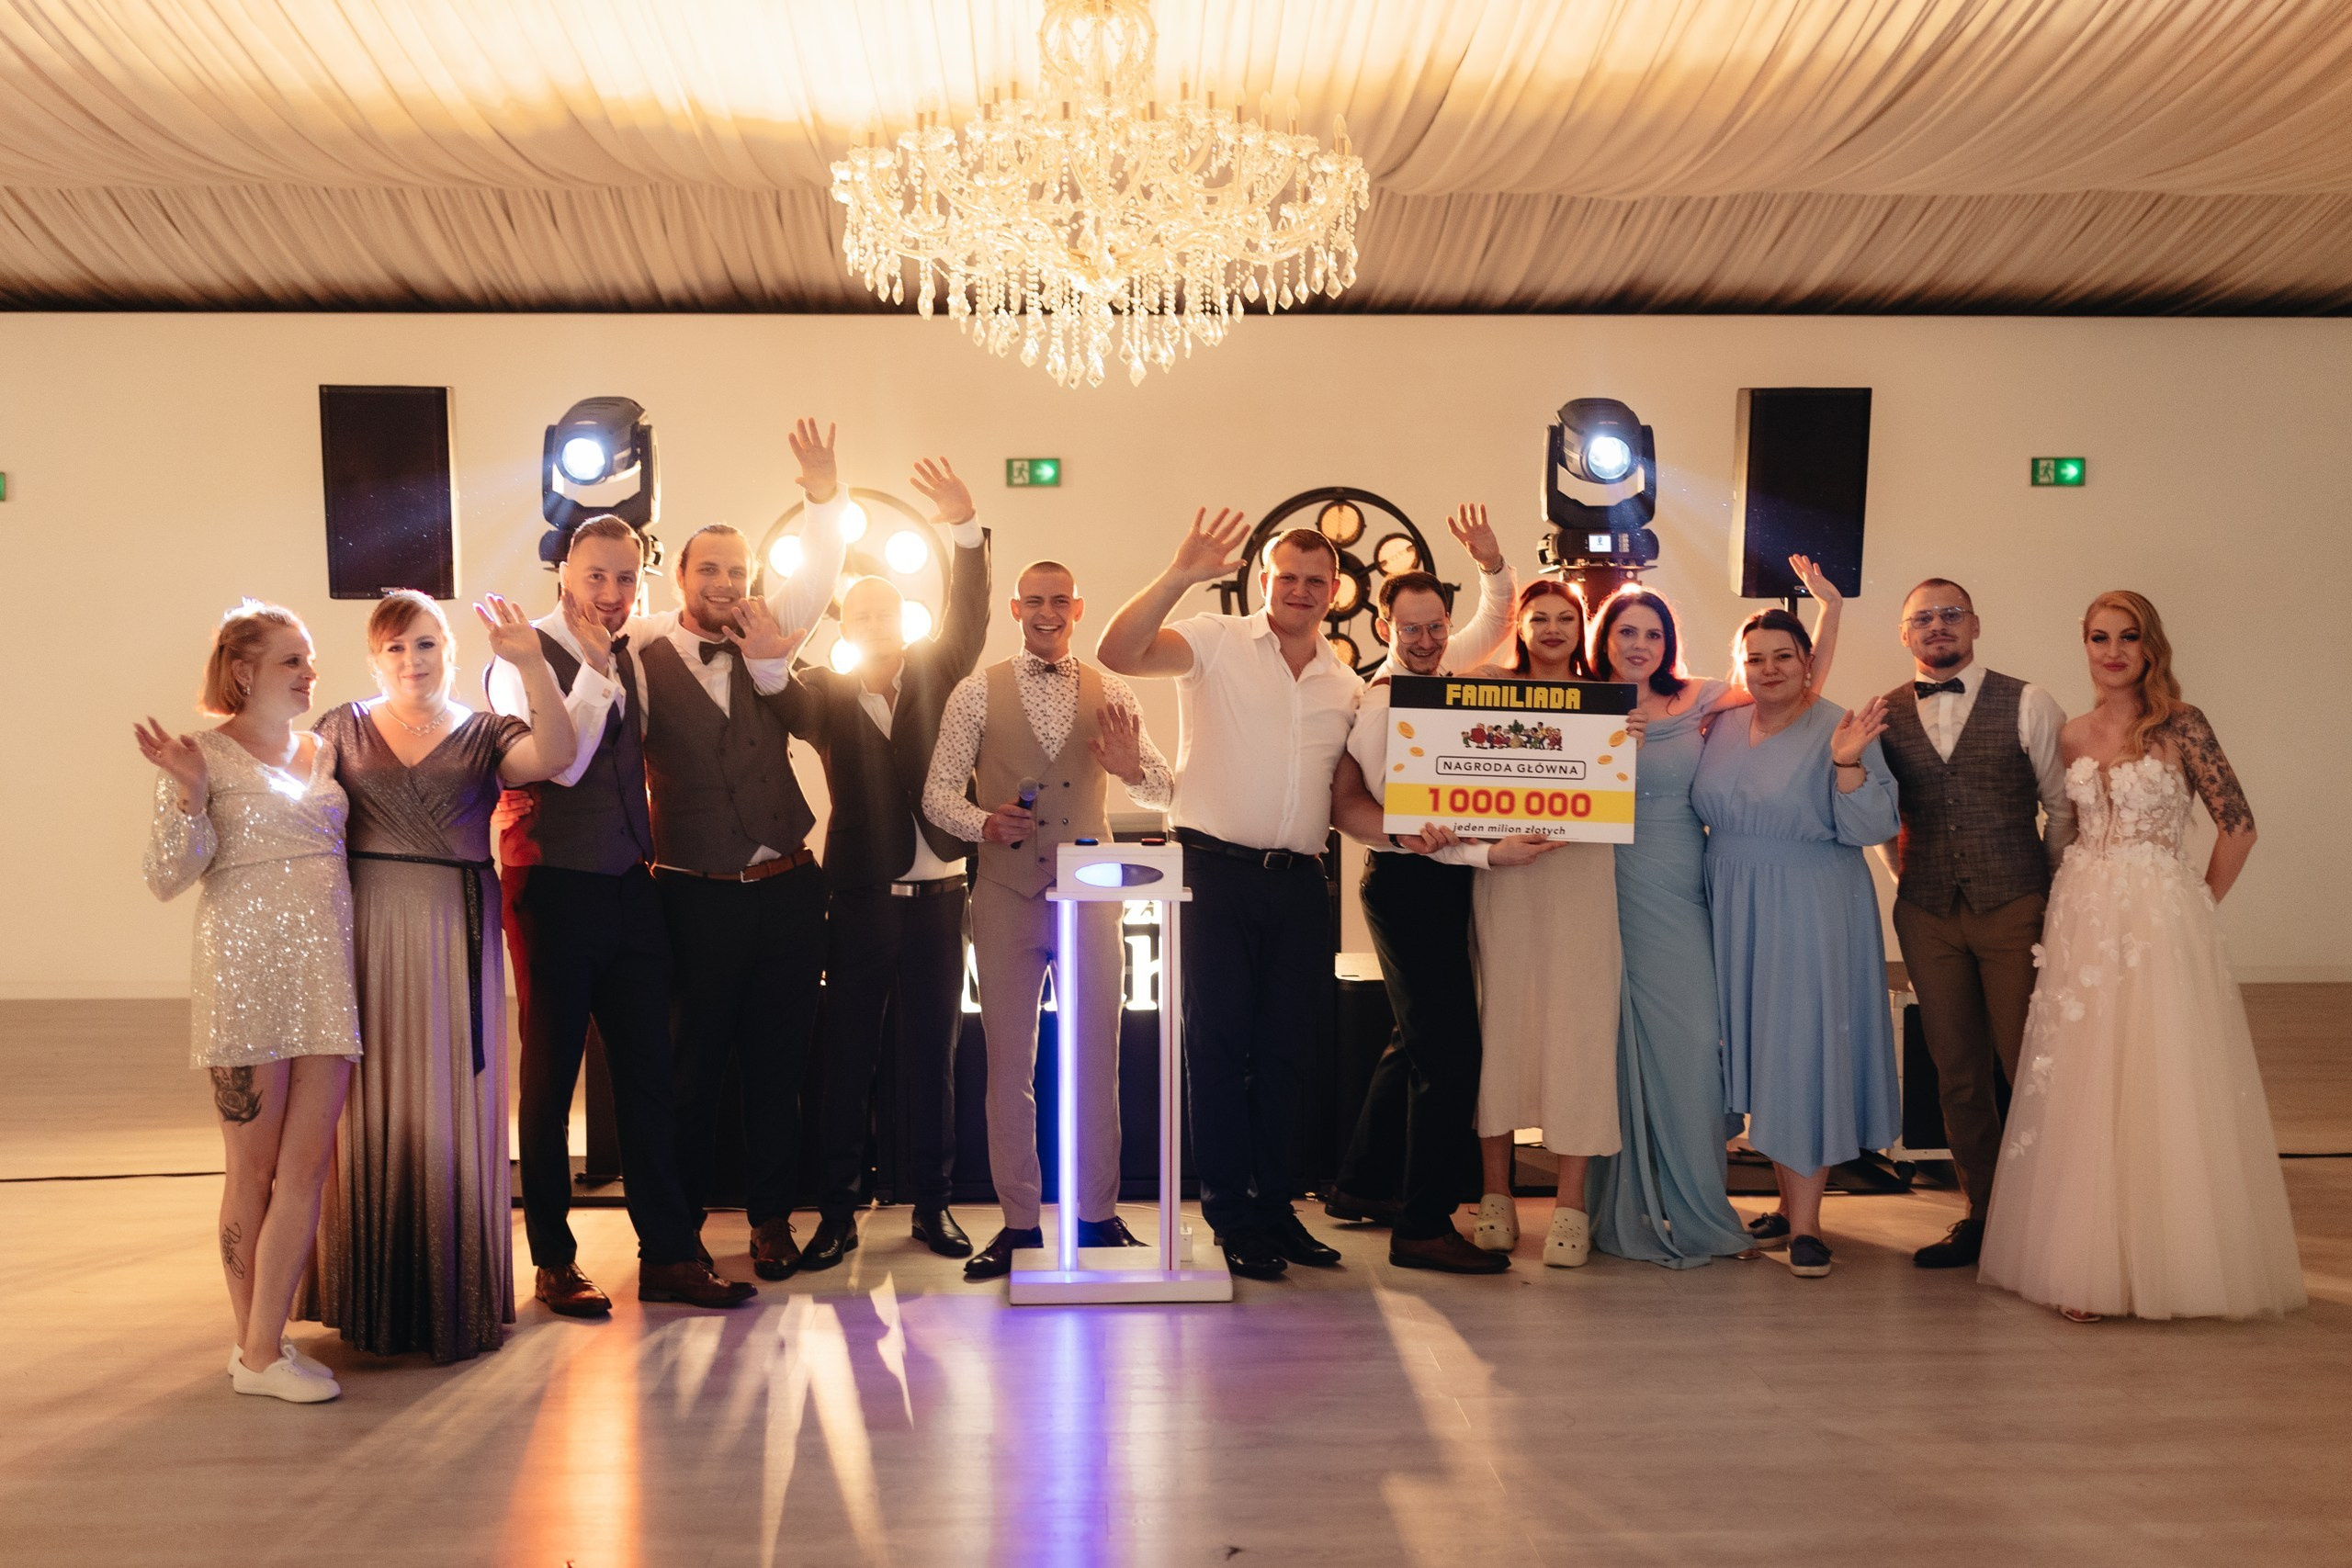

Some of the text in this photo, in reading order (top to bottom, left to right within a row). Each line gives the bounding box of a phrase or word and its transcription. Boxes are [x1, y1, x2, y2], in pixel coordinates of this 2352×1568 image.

[1445, 683, 1581, 710] FAMILIADA
[1442, 761, 1578, 775] NAGRODA GŁÓWNA
[1429, 787, 1591, 818] 1 000 000
[1453, 822, 1566, 837] jeden milion złotych
